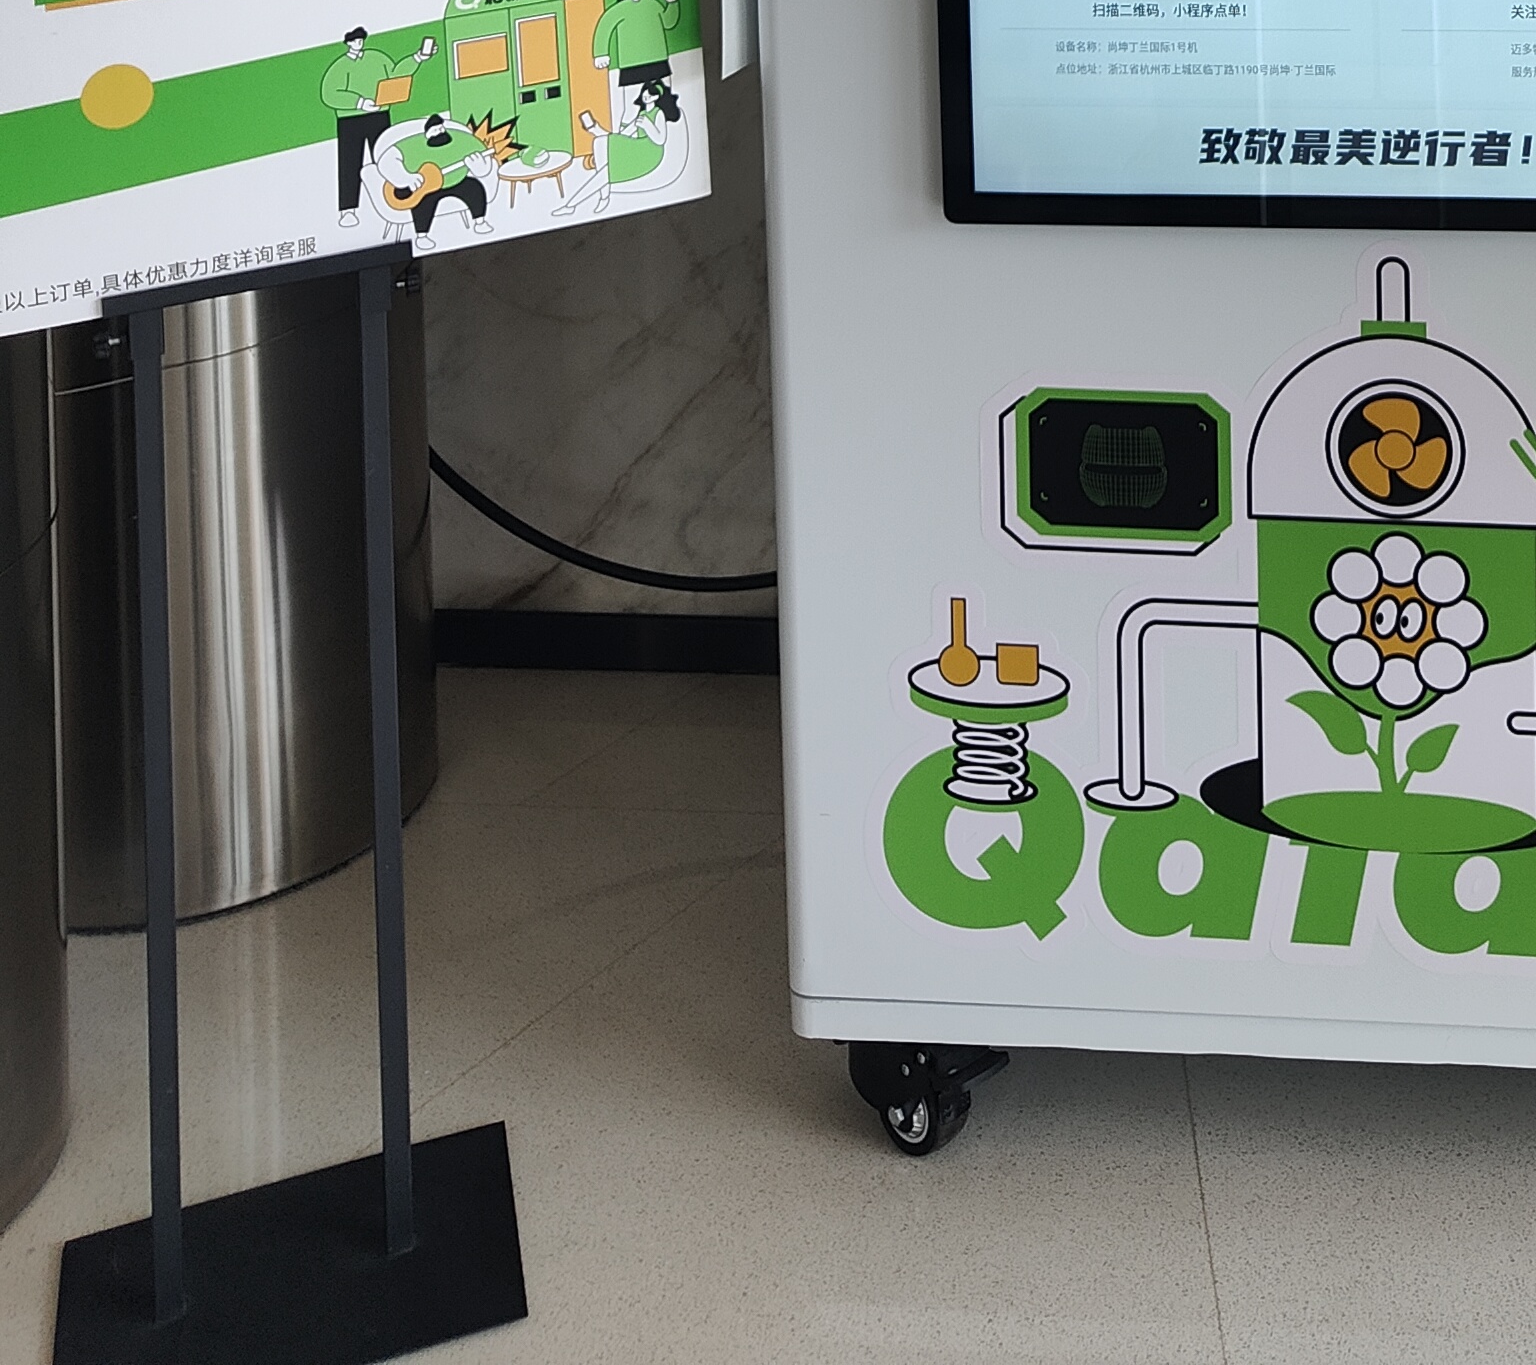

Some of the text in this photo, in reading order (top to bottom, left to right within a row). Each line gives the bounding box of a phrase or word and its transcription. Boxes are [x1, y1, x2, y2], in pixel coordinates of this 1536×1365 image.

[1199, 127, 1534, 167] 致敬最美逆行者！
[0, 236, 317, 313] 以上订单,具体优惠力度详询客服
